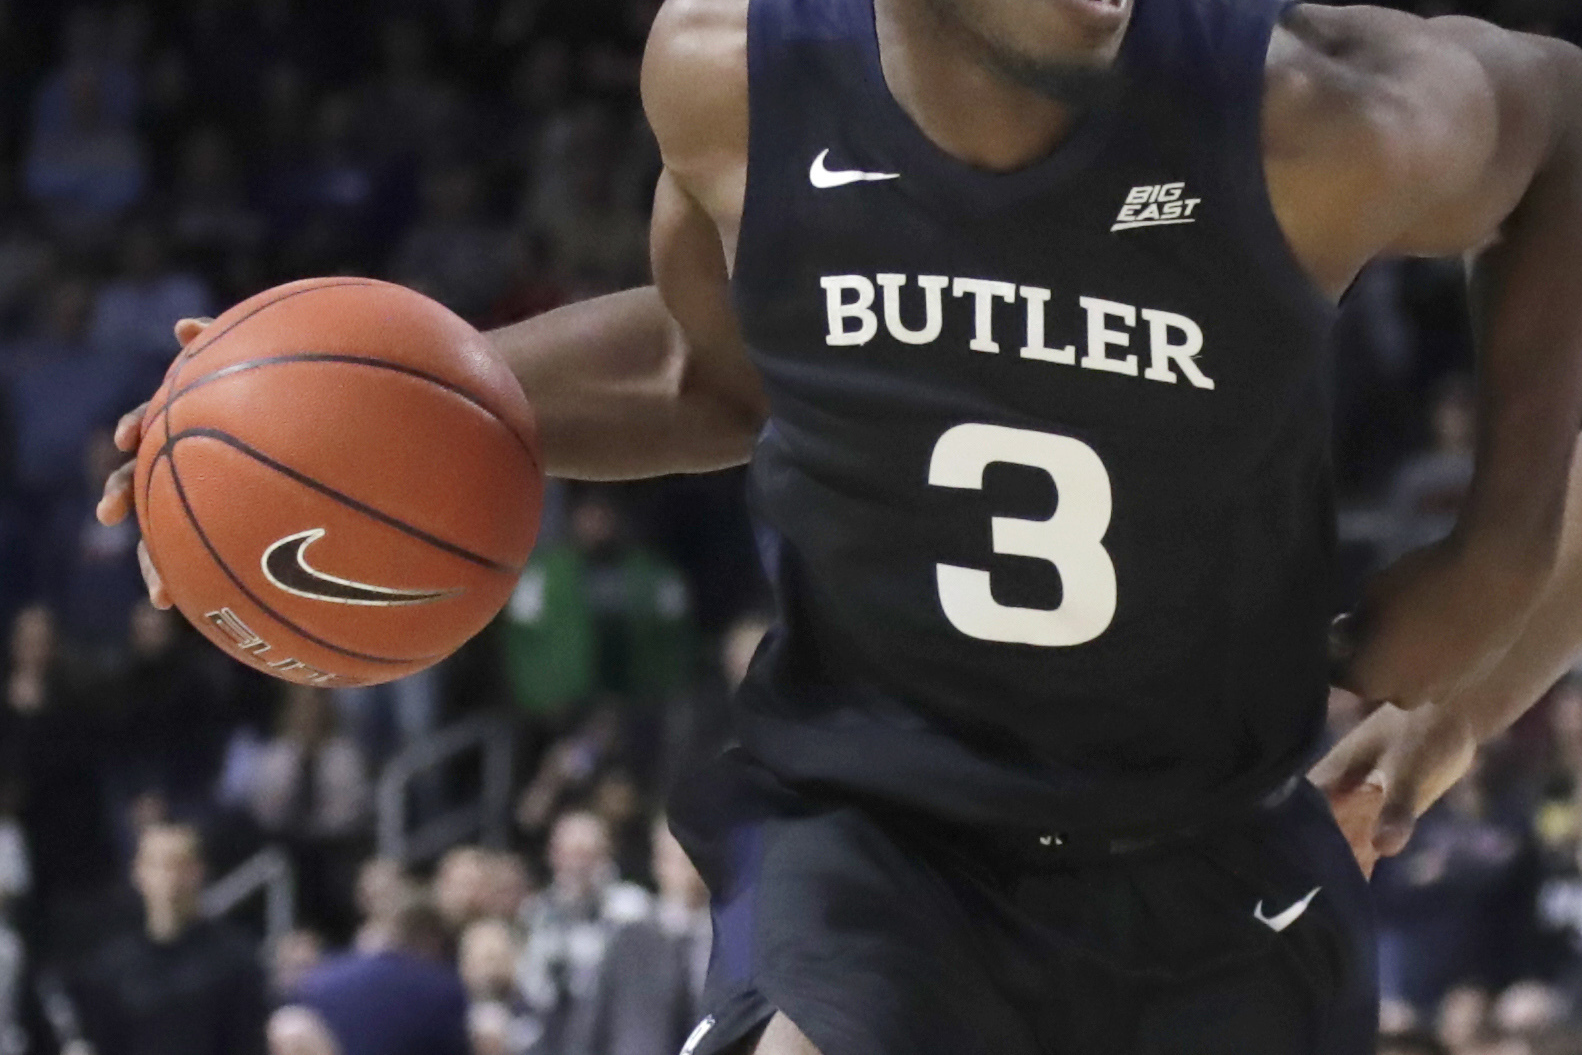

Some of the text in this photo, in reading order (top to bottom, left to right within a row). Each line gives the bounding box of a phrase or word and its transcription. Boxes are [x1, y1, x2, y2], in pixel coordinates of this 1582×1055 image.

[1116, 198, 1201, 221] EAST
[1125, 182, 1185, 204] BIG
[820, 273, 1215, 390] BUTLER
[928, 423, 1117, 646] 3
